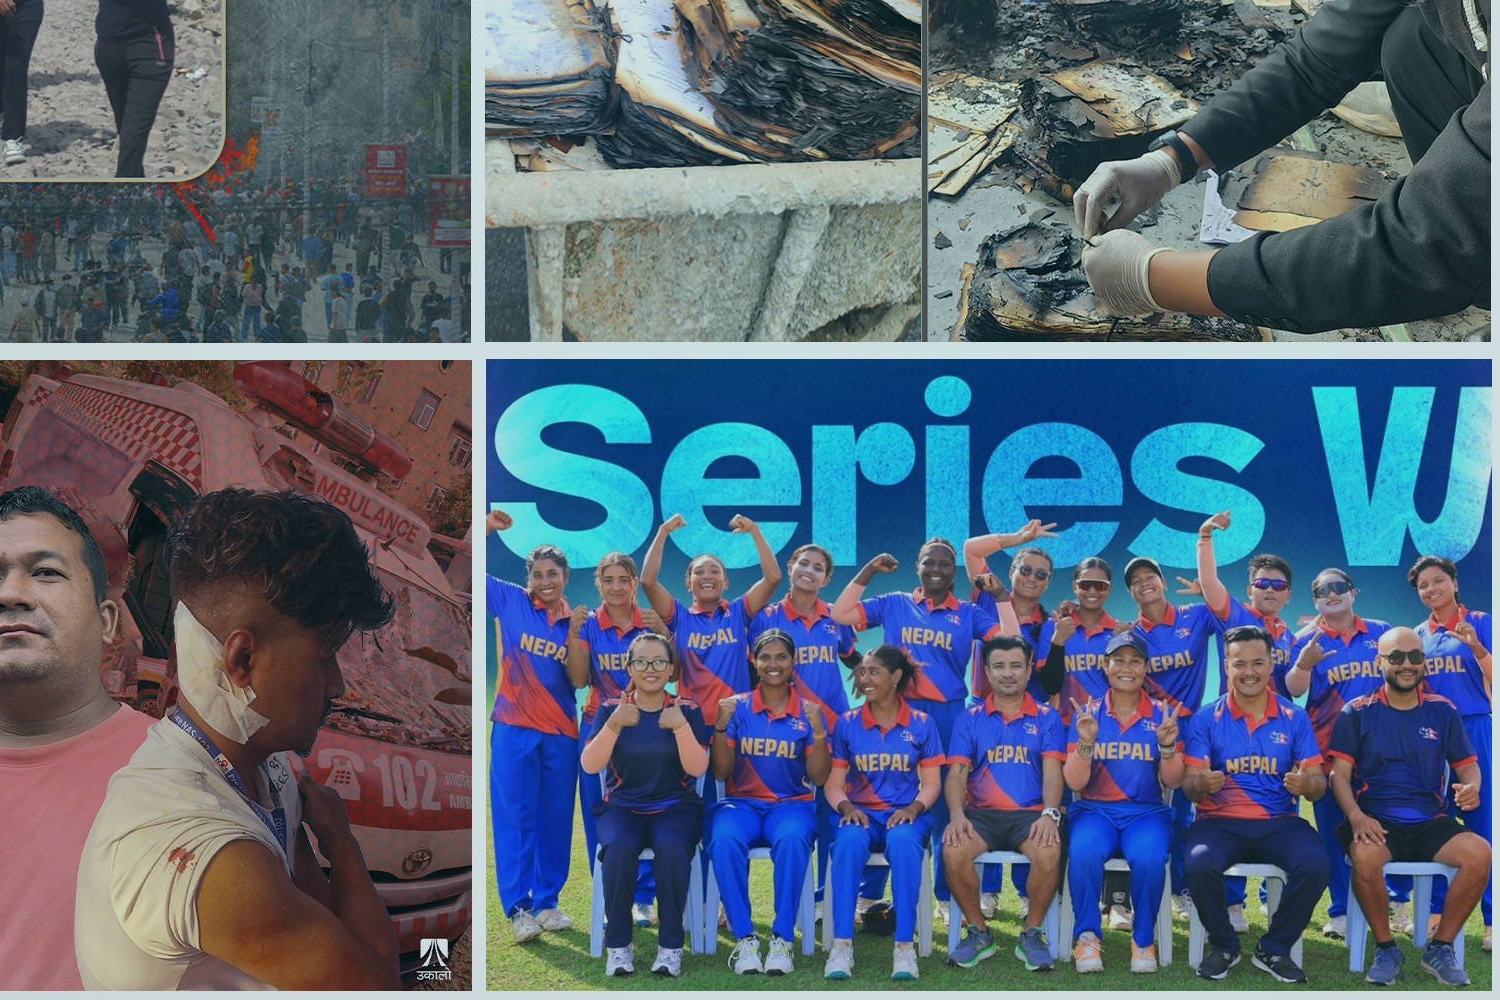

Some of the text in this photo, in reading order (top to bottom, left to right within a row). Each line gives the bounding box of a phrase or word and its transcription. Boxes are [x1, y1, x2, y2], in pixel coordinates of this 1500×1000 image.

[489, 375, 1266, 568] Series
[901, 627, 953, 650] NEPAL
[520, 633, 569, 666] NEPA
[597, 653, 628, 671] NEP
[1064, 653, 1106, 672] NEPA
[741, 737, 797, 759] NEPAL
[1093, 742, 1154, 761] NEPAL
[855, 753, 911, 772] NEPAL
[1226, 755, 1279, 775] NEPAL
[373, 753, 442, 811] 102
